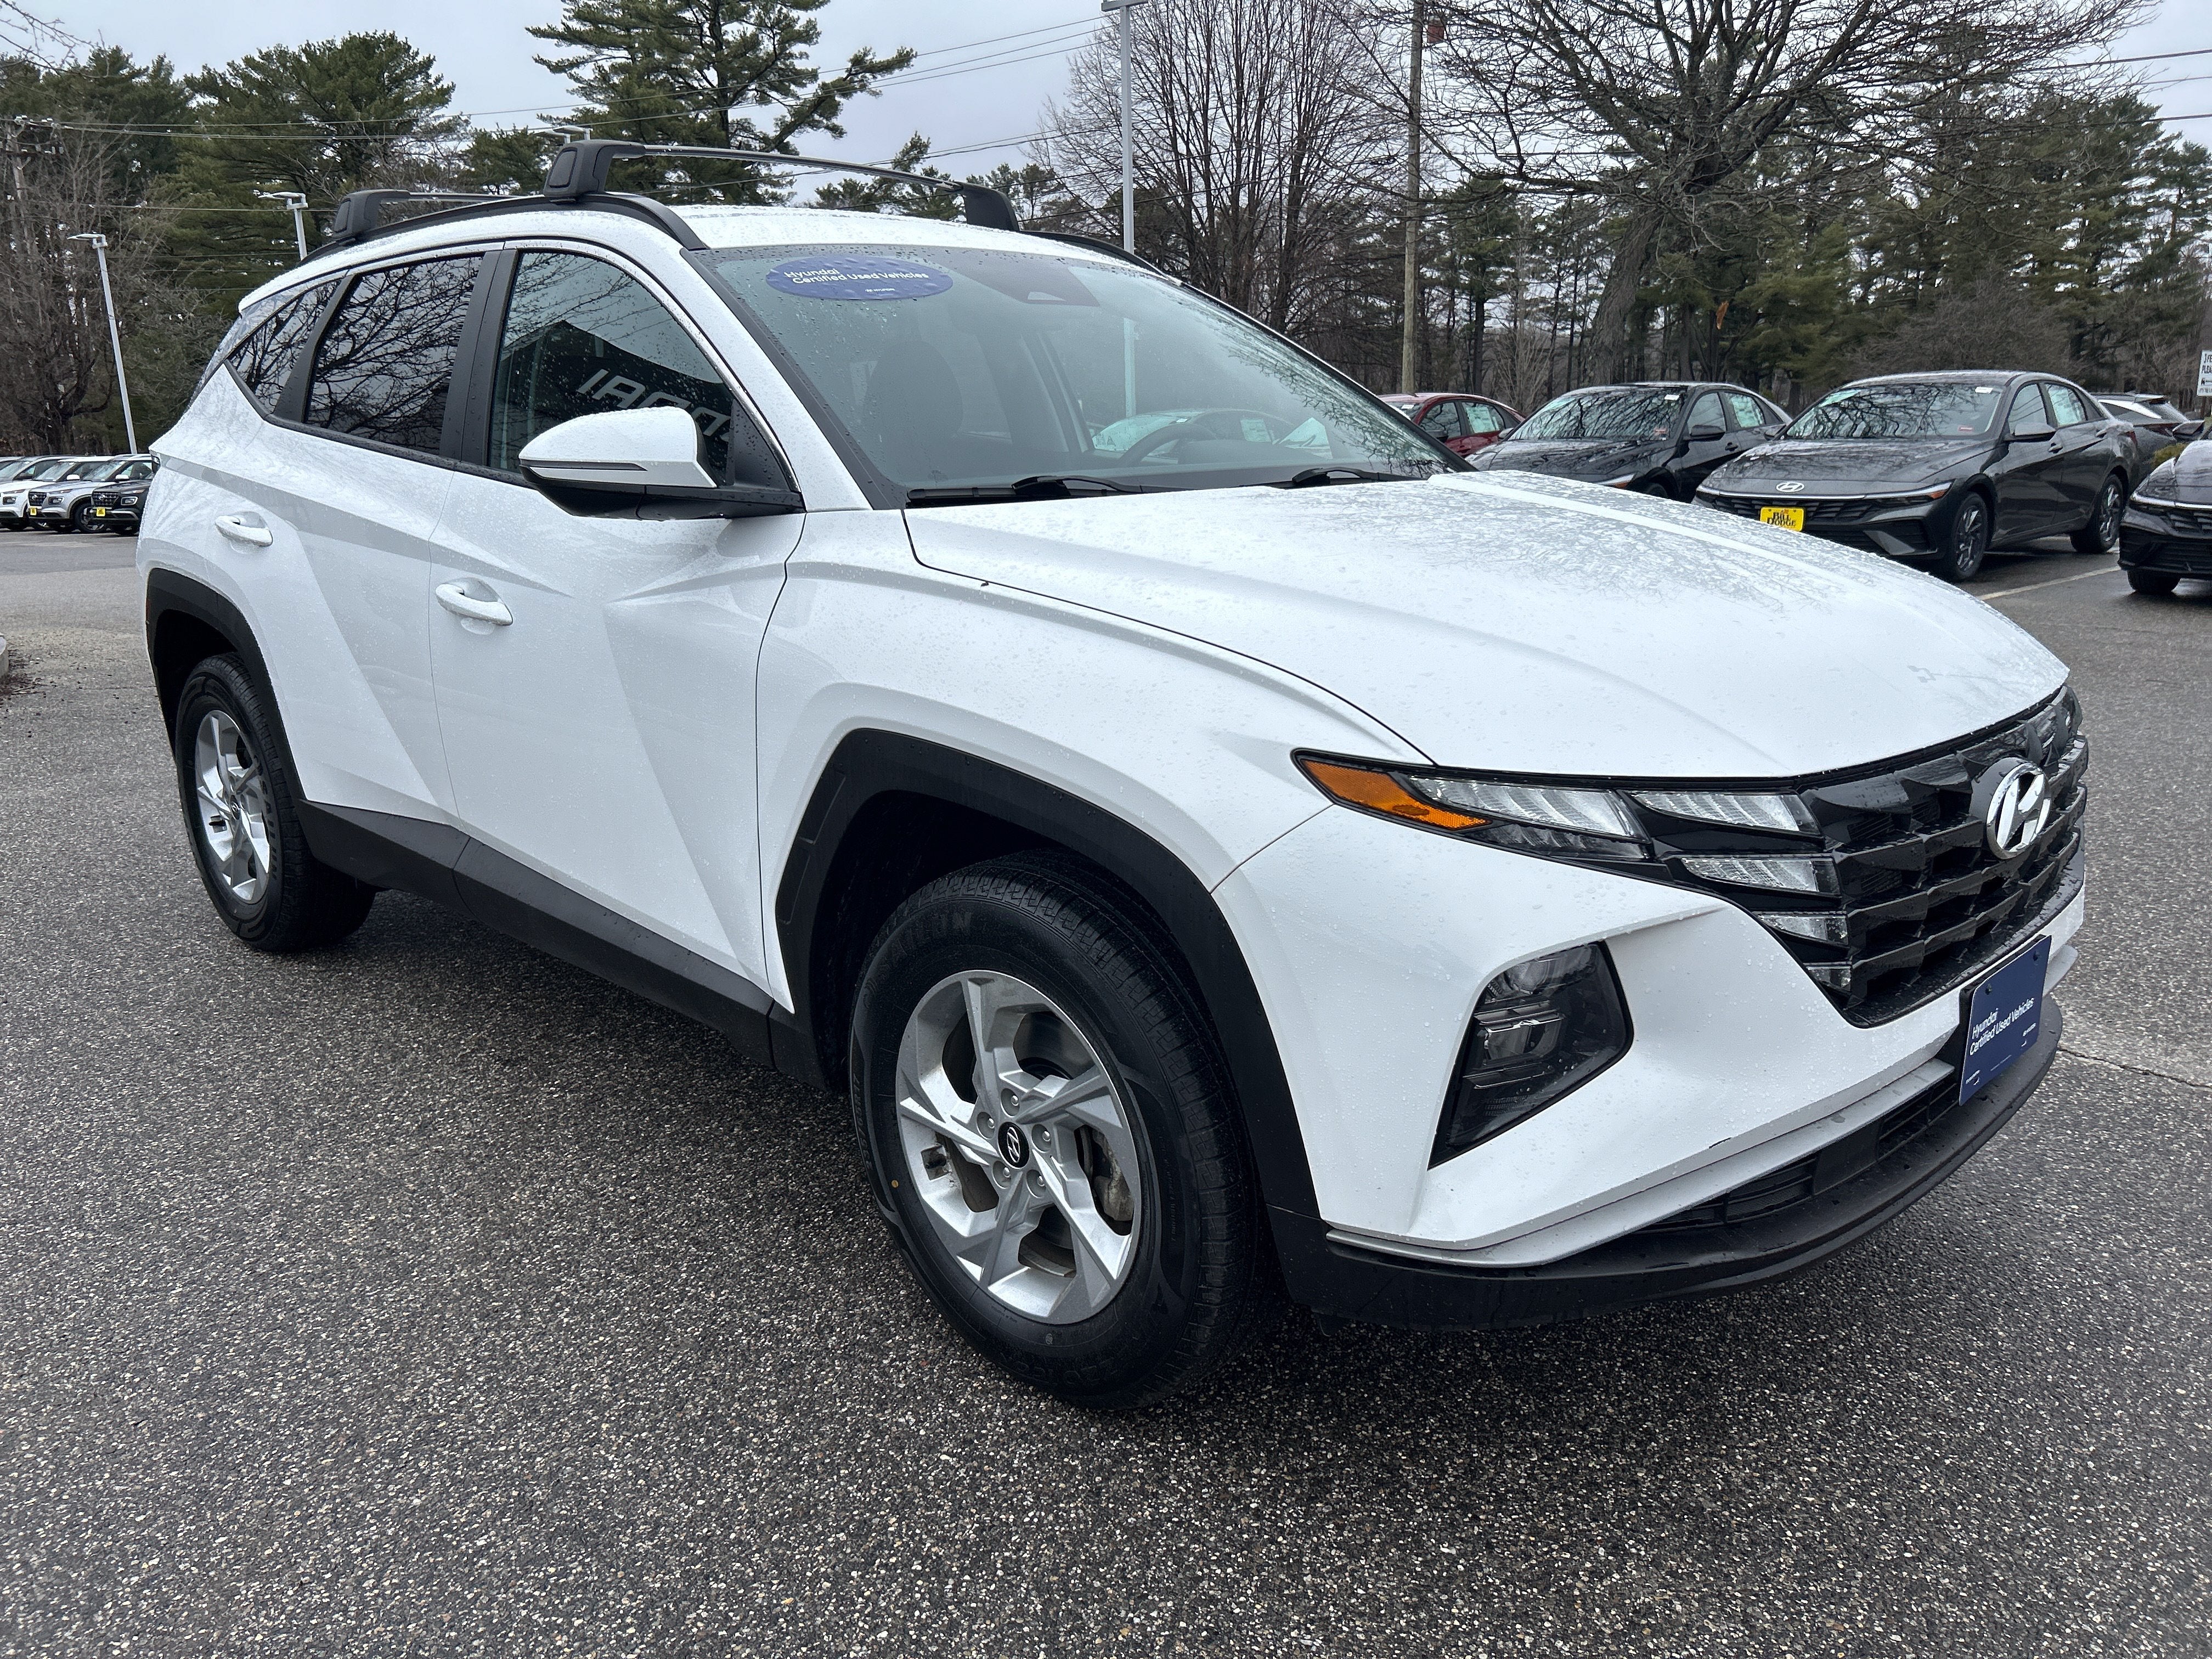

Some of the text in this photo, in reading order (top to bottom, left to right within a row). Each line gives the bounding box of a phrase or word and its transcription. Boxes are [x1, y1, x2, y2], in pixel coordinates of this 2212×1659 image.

[784, 268, 840, 278] Hyundai
[793, 275, 848, 284] Certified
[1773, 512, 1791, 520] BILL
[1970, 1024, 1996, 1056] Certified
[1995, 1012, 2012, 1035] Used
[2011, 997, 2035, 1023] Vehicles
[1972, 1007, 1999, 1039] Hyundai
